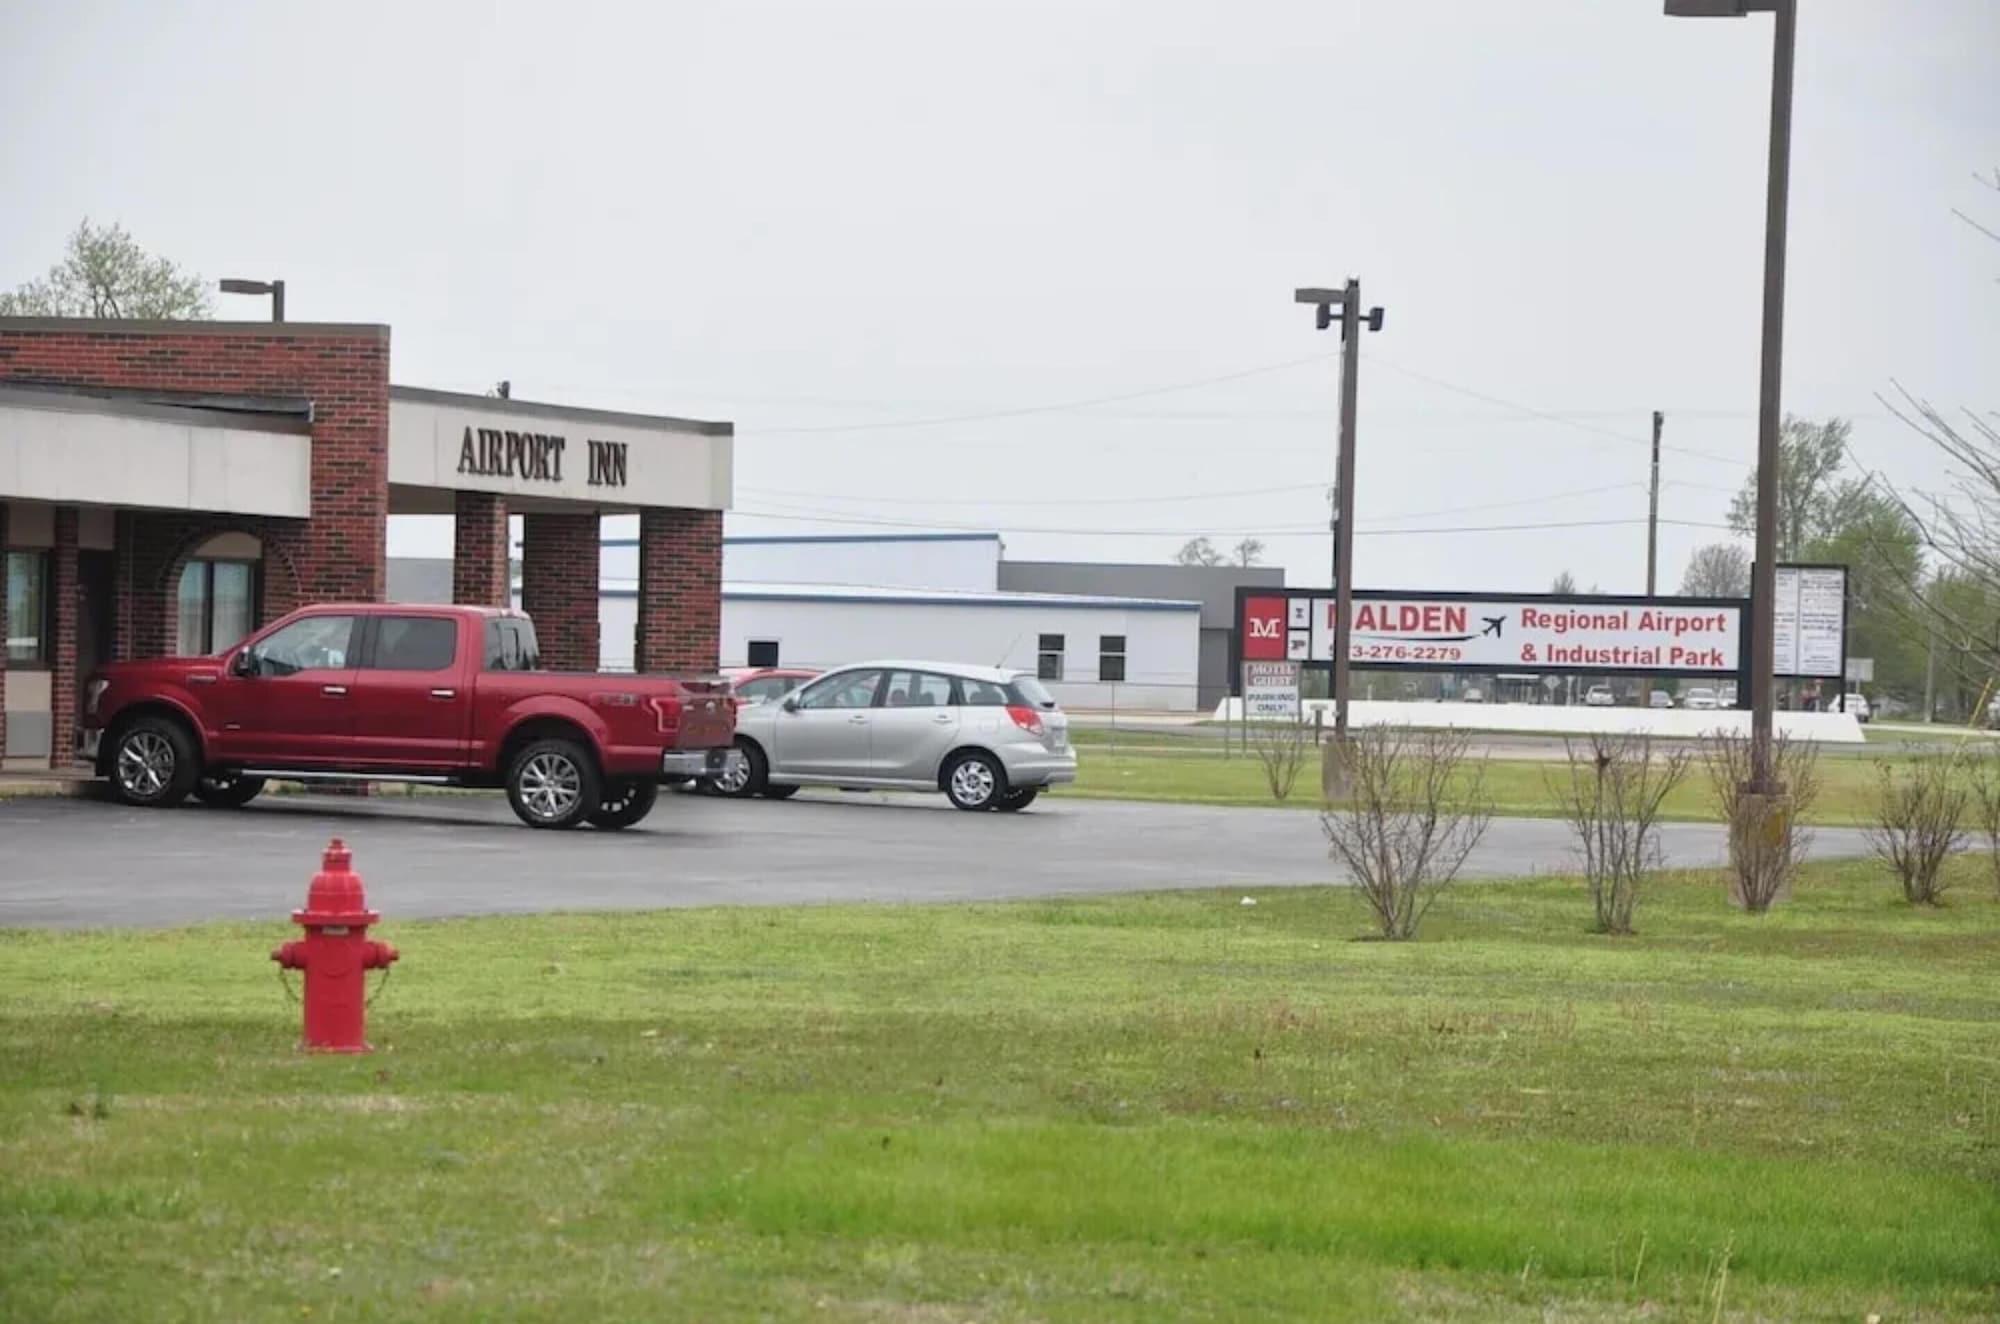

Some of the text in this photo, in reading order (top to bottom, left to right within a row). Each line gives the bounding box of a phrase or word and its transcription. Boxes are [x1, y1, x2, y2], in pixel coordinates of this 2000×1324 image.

[457, 426, 628, 487] AIRPORT INN
[1249, 618, 1280, 638] M
[1521, 608, 1727, 636] Regional Airport
[1328, 645, 1461, 660] 3-276-2279
[1520, 643, 1724, 667] & Industrial Park
